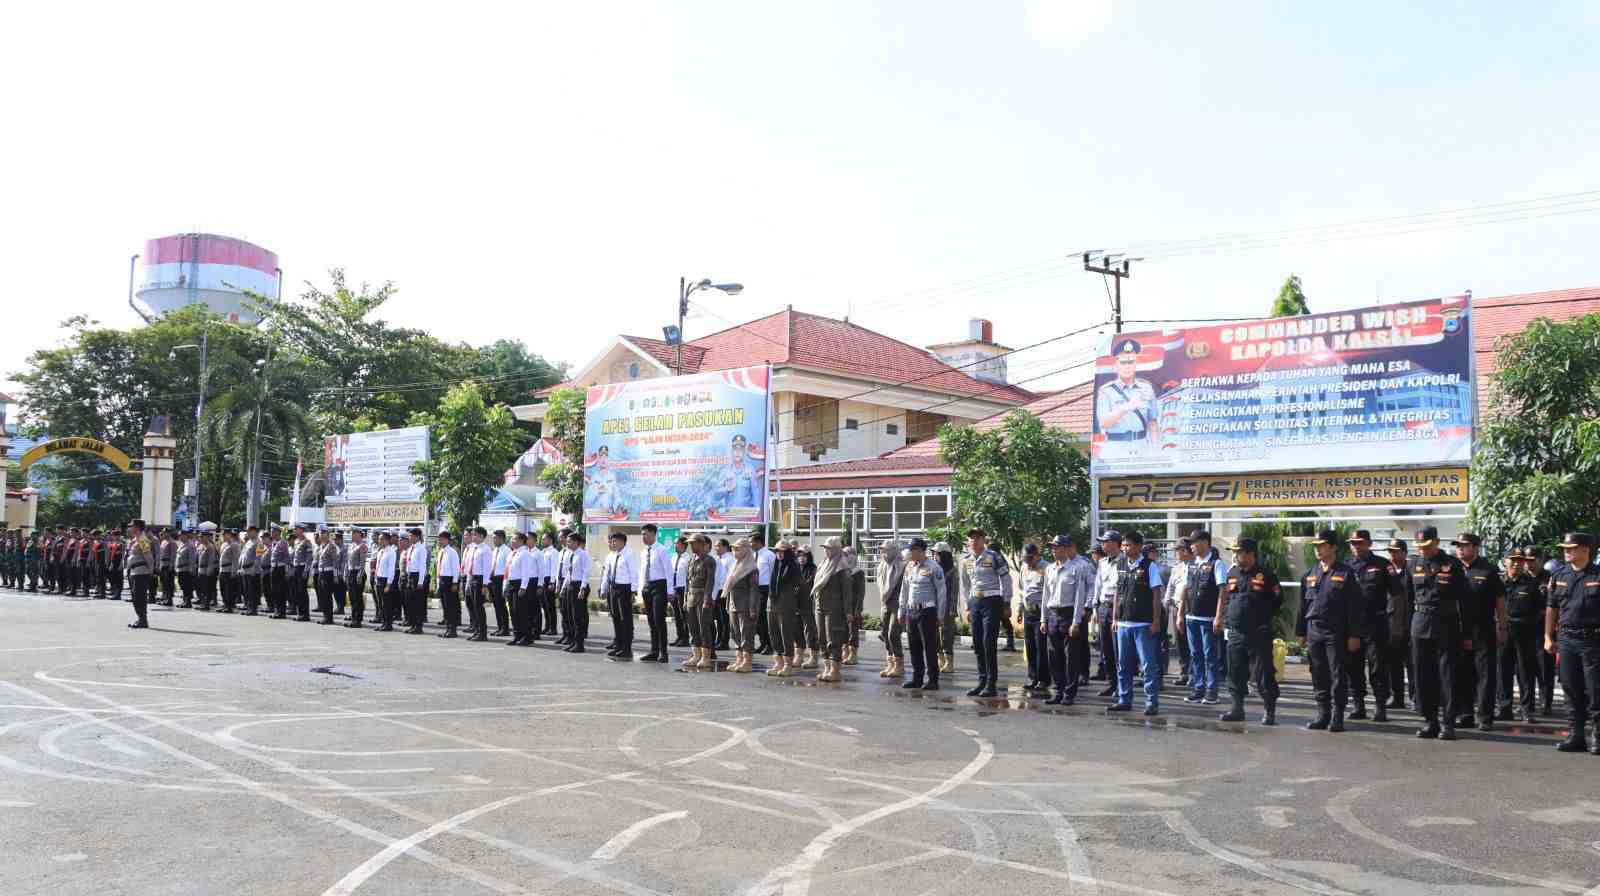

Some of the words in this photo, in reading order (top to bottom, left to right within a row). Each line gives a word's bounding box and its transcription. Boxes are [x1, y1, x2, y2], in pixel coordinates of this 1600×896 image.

[1220, 315, 1356, 343] COMMANDER
[1361, 306, 1427, 329] WISH
[1230, 336, 1328, 361] KAPOLDA
[1181, 374, 1235, 388] BERTAKWA
[1236, 371, 1277, 385] KEPADA
[1279, 367, 1316, 380] TUHAN
[1318, 366, 1348, 378] YANG
[1350, 363, 1386, 375] MAHA
[1387, 360, 1412, 372] ESA
[1320, 379, 1377, 394] PRESIDEN
[1379, 378, 1405, 390] DAN
[1407, 373, 1461, 388] KAPOLRI
[1262, 398, 1366, 414] PROFESIONALISME
[677, 408, 745, 429] PASUKAN
[1183, 420, 1252, 433] MENCIPTAKAN
[1253, 417, 1309, 431] SOLIDITAS
[1311, 414, 1366, 427] INTERNAL
[1368, 413, 1378, 424] &
[1380, 409, 1450, 423] INTEGRITAS
[1104, 480, 1240, 503] PRESISI
[1245, 479, 1316, 489] PREDIKTIF
[1324, 474, 1459, 487] RESPONSIBILITAS
[1247, 488, 1349, 500] TRANSPARANSI
[1354, 487, 1459, 499] BERKEADILAN
